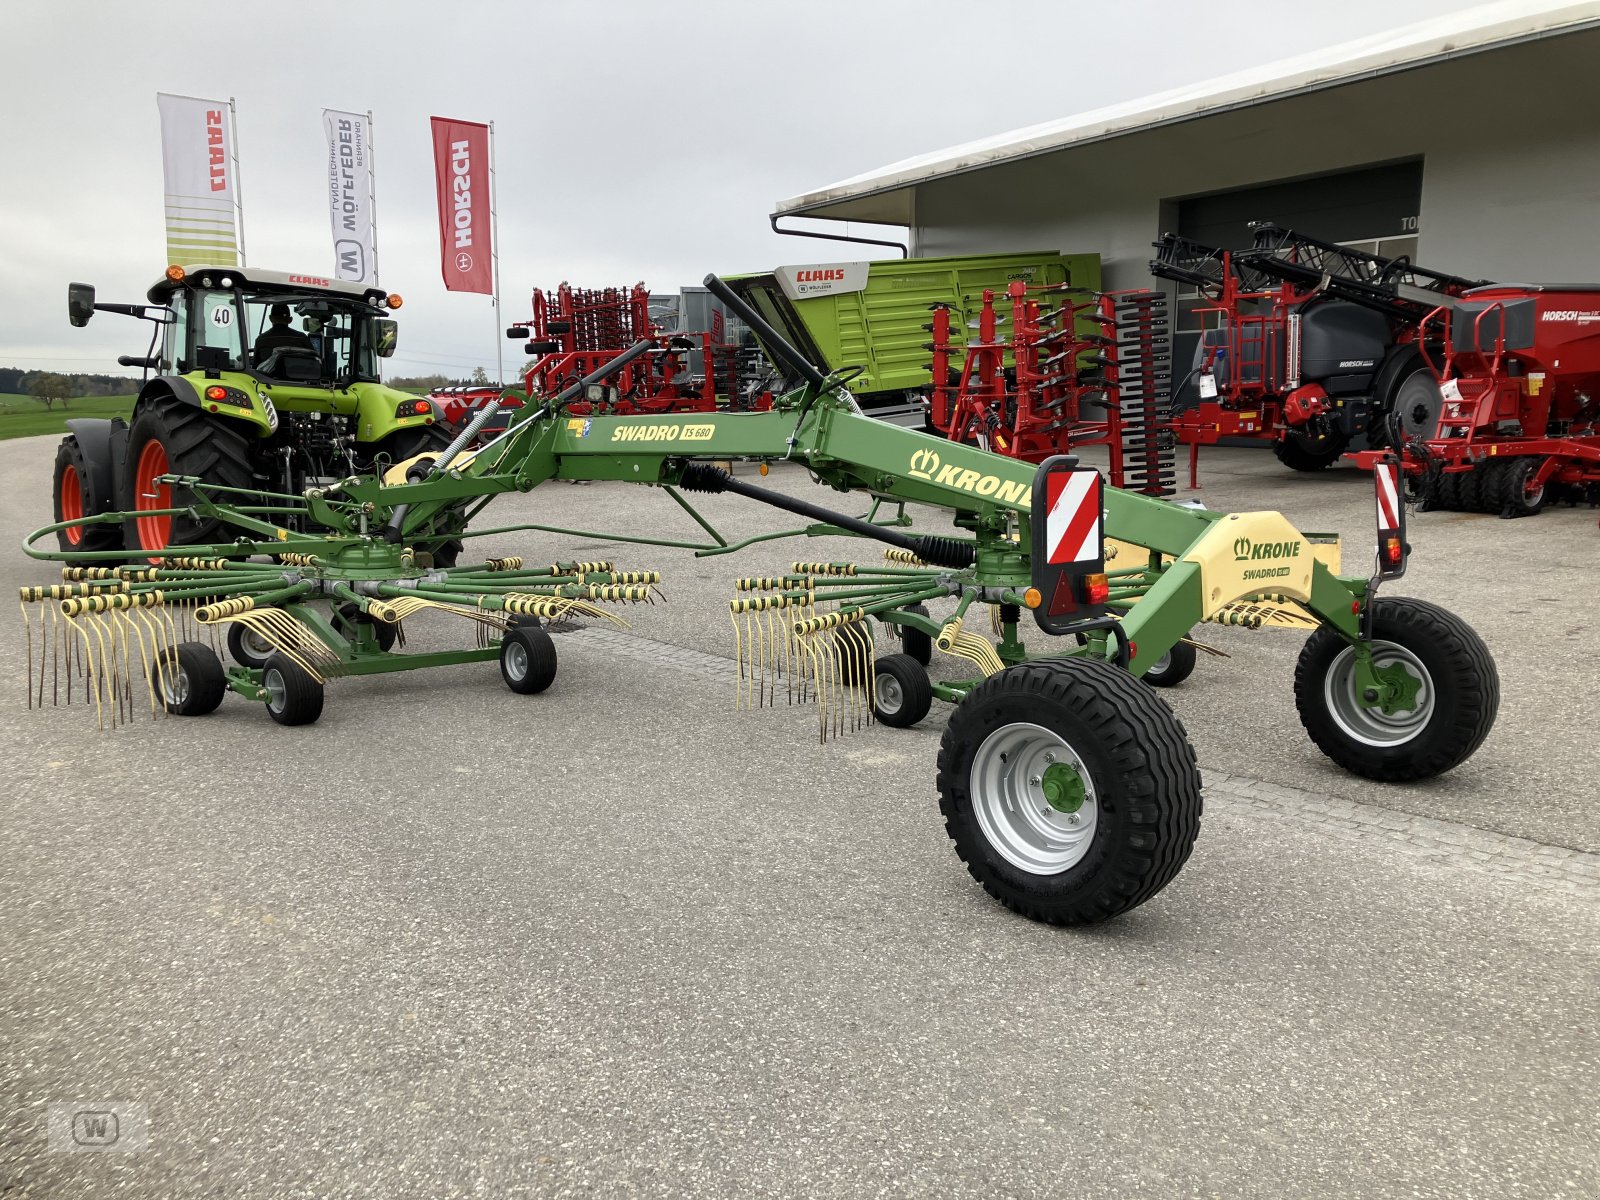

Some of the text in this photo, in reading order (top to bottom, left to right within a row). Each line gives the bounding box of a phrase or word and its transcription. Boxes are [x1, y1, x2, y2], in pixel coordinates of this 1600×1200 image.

[289, 275, 329, 287] CLAAS
[797, 269, 844, 282] CLAAS
[214, 309, 230, 324] 40
[1542, 310, 1578, 321] HORSCH
[1340, 360, 1363, 368] HORSCH
[611, 425, 711, 441] SWADRO TS 680
[1251, 541, 1301, 560] KRONE
[1243, 568, 1277, 580] SWADRO
